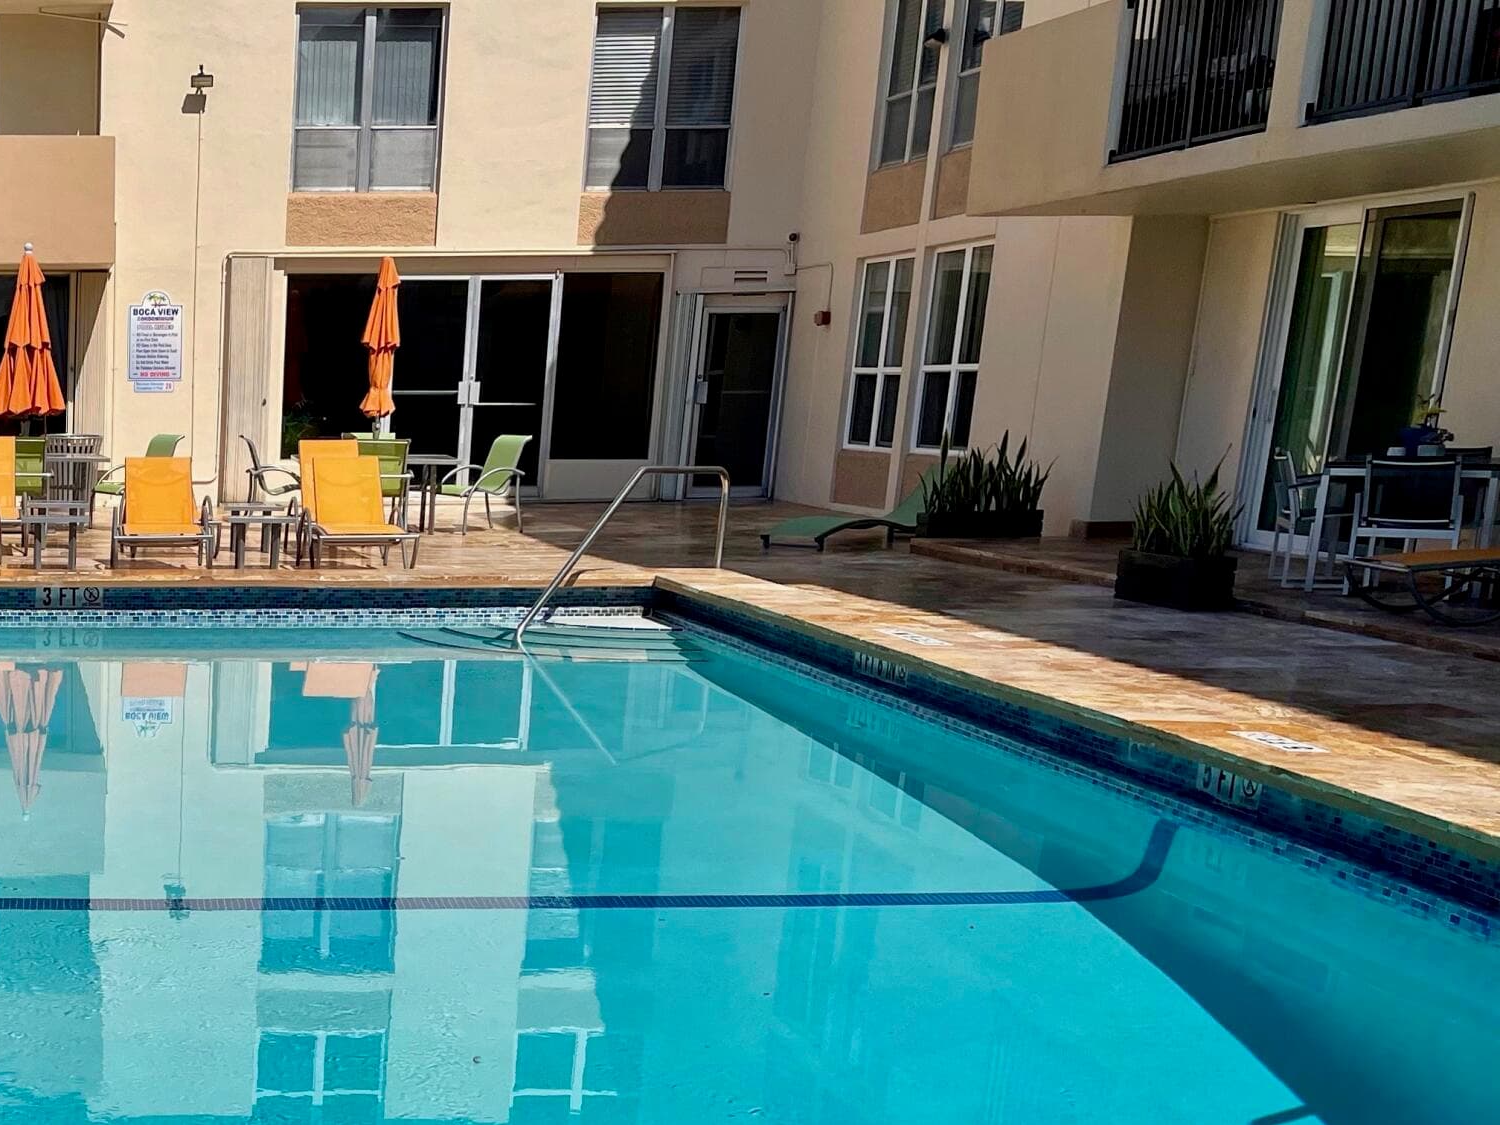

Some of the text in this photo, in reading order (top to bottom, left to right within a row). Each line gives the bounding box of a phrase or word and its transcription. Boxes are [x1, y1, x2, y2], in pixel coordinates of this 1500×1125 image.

[133, 308, 179, 316] BOCA VIEW
[42, 587, 79, 606] 3 FT
